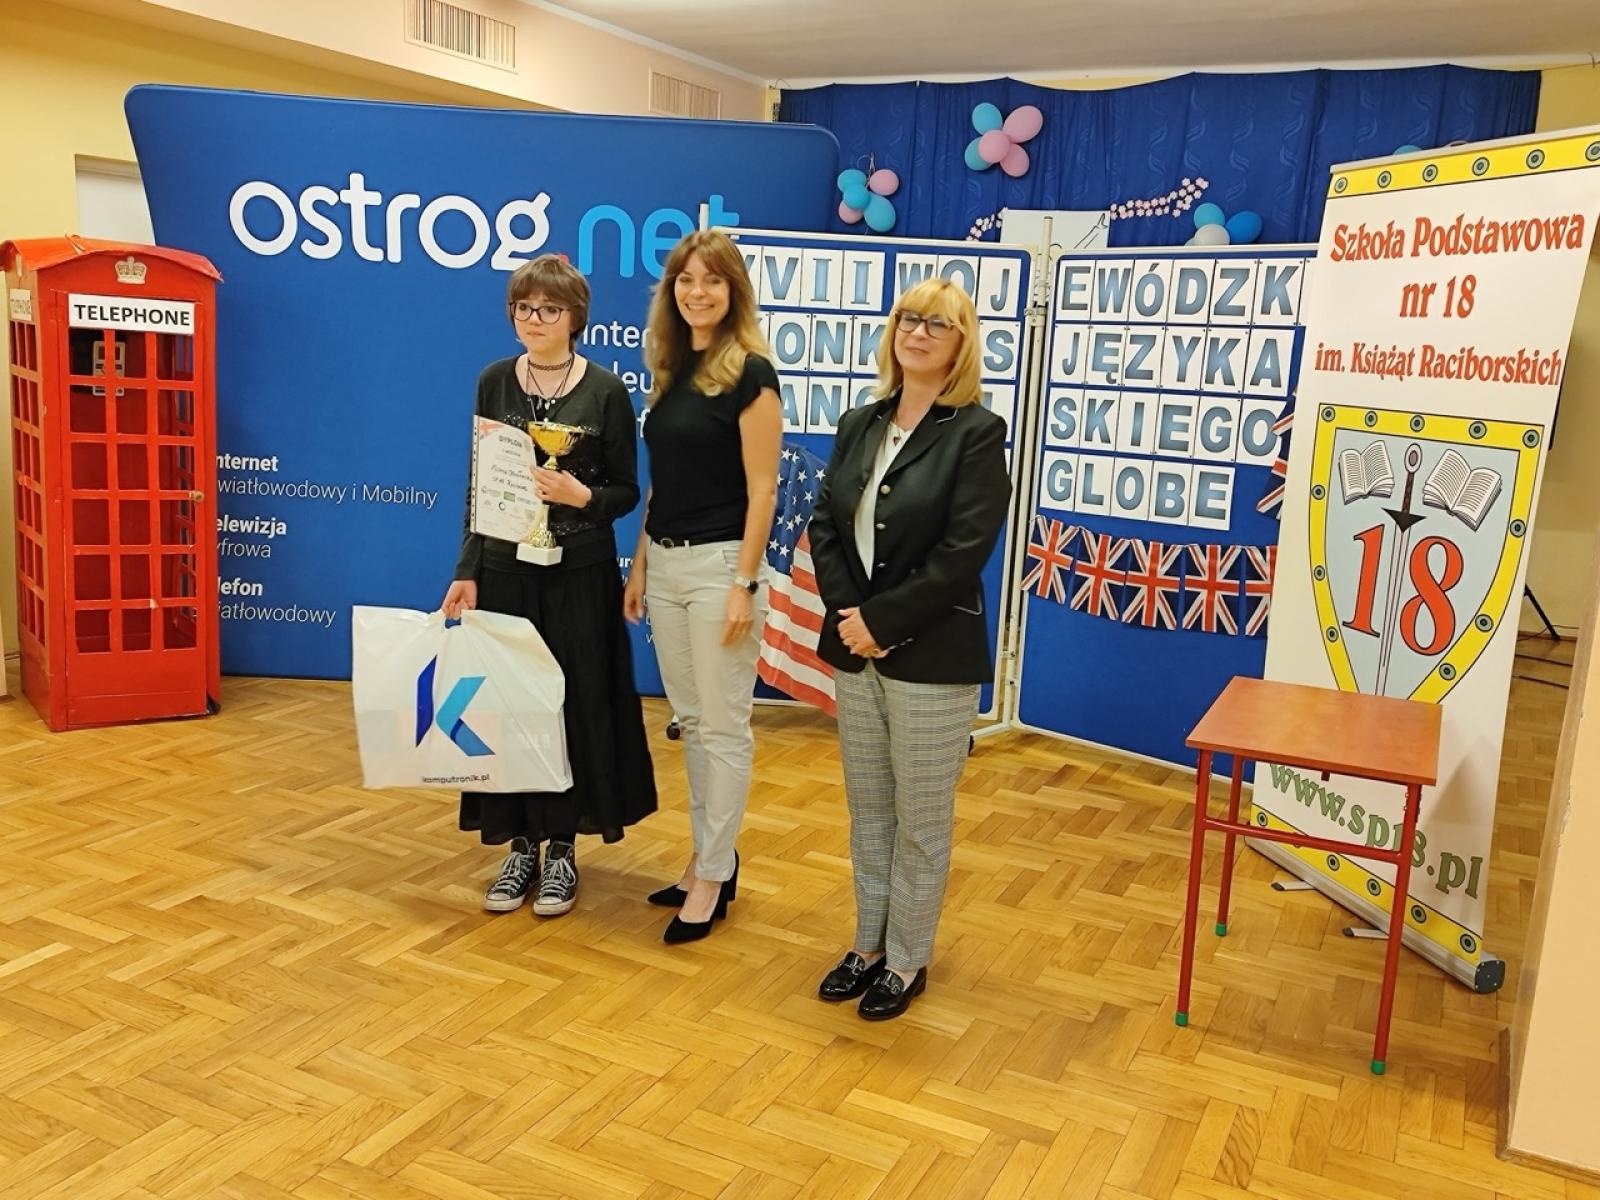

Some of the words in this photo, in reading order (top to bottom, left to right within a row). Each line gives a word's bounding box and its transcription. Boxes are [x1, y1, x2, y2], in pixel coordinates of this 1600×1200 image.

[229, 172, 551, 271] ostrog
[1330, 219, 1405, 262] Szkoła
[1411, 213, 1585, 257] Podstawowa
[744, 254, 873, 305] VII
[1399, 280, 1437, 318] nr
[1443, 274, 1477, 318] 18
[74, 304, 190, 326] TELEPHONE
[1062, 332, 1282, 388] JĘZYKA
[1314, 342, 1345, 372] im.
[1350, 341, 1416, 381] Książąt
[1418, 344, 1562, 386] Raciborskich
[1050, 397, 1279, 457] SKIEGO
[217, 453, 279, 472] nternet
[218, 476, 347, 505] wiatłowodowy
[351, 484, 357, 501] i
[363, 484, 438, 510] Mobilny
[1046, 459, 1230, 521] GLOBE
[217, 515, 287, 539] elewizja
[1342, 523, 1464, 656] 18
